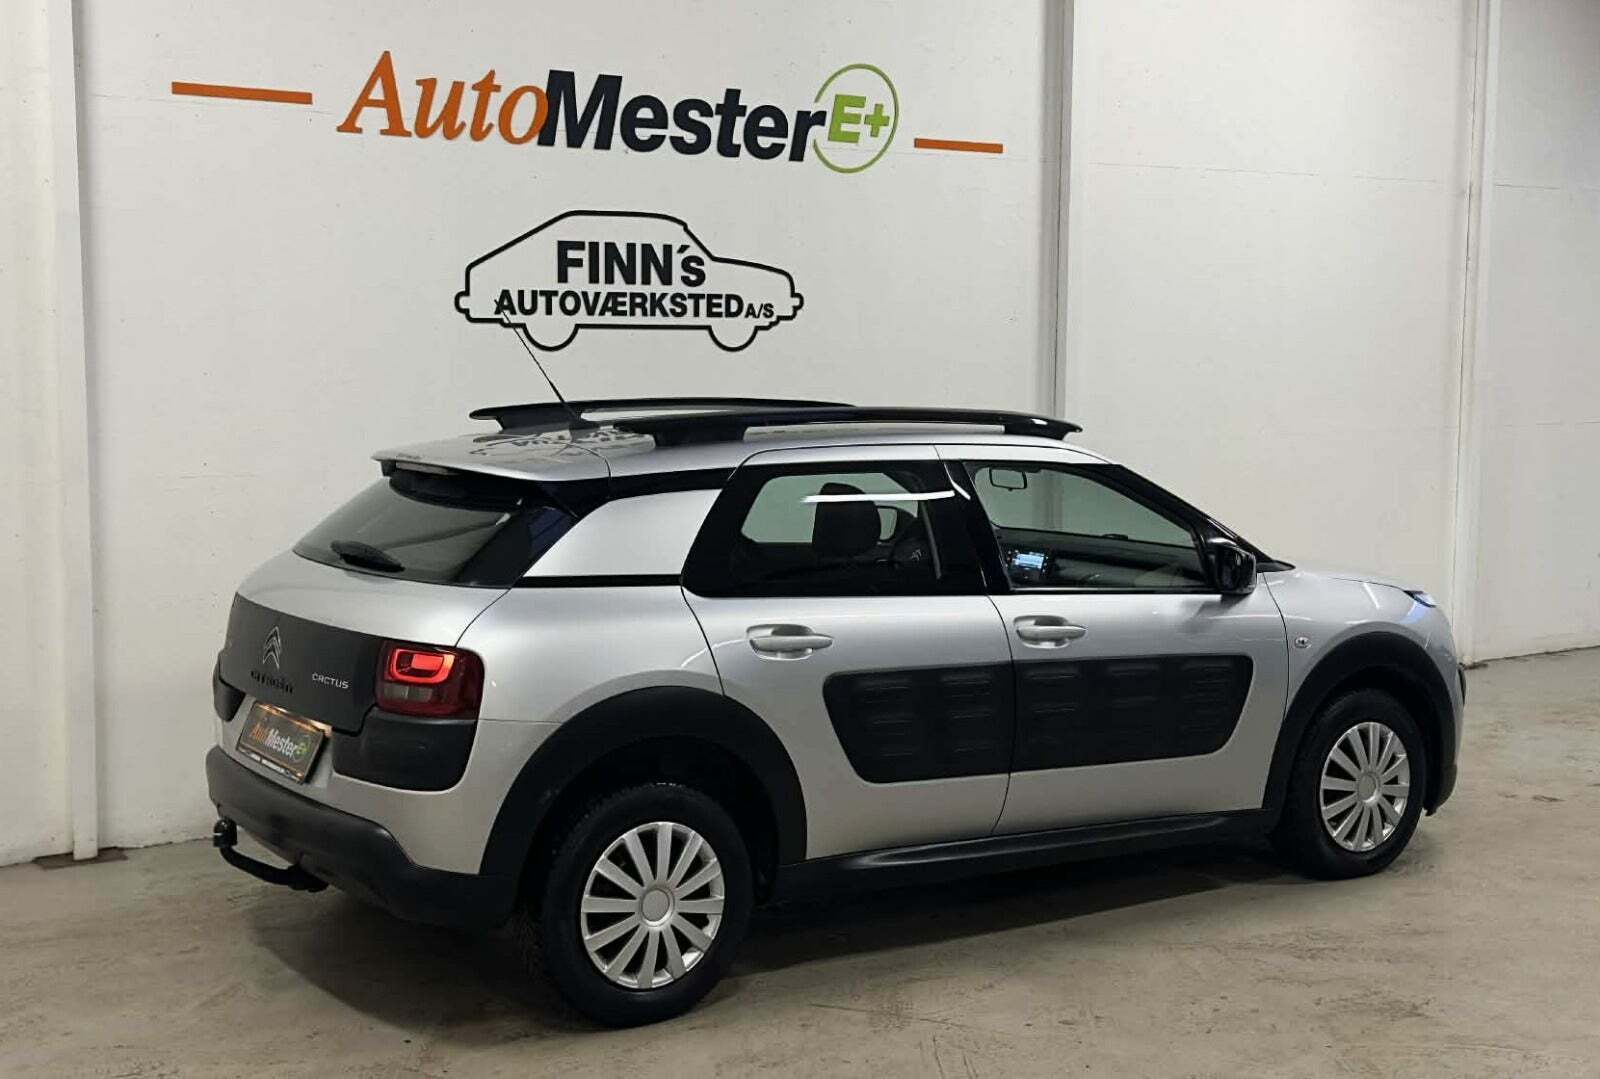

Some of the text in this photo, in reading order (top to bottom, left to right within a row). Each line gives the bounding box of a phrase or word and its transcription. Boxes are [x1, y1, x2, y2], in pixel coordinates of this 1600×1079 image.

[337, 51, 827, 162] AutoMester
[495, 289, 775, 319] AUTOVÆRKSTED A/S
[311, 672, 349, 689] CACTUS
